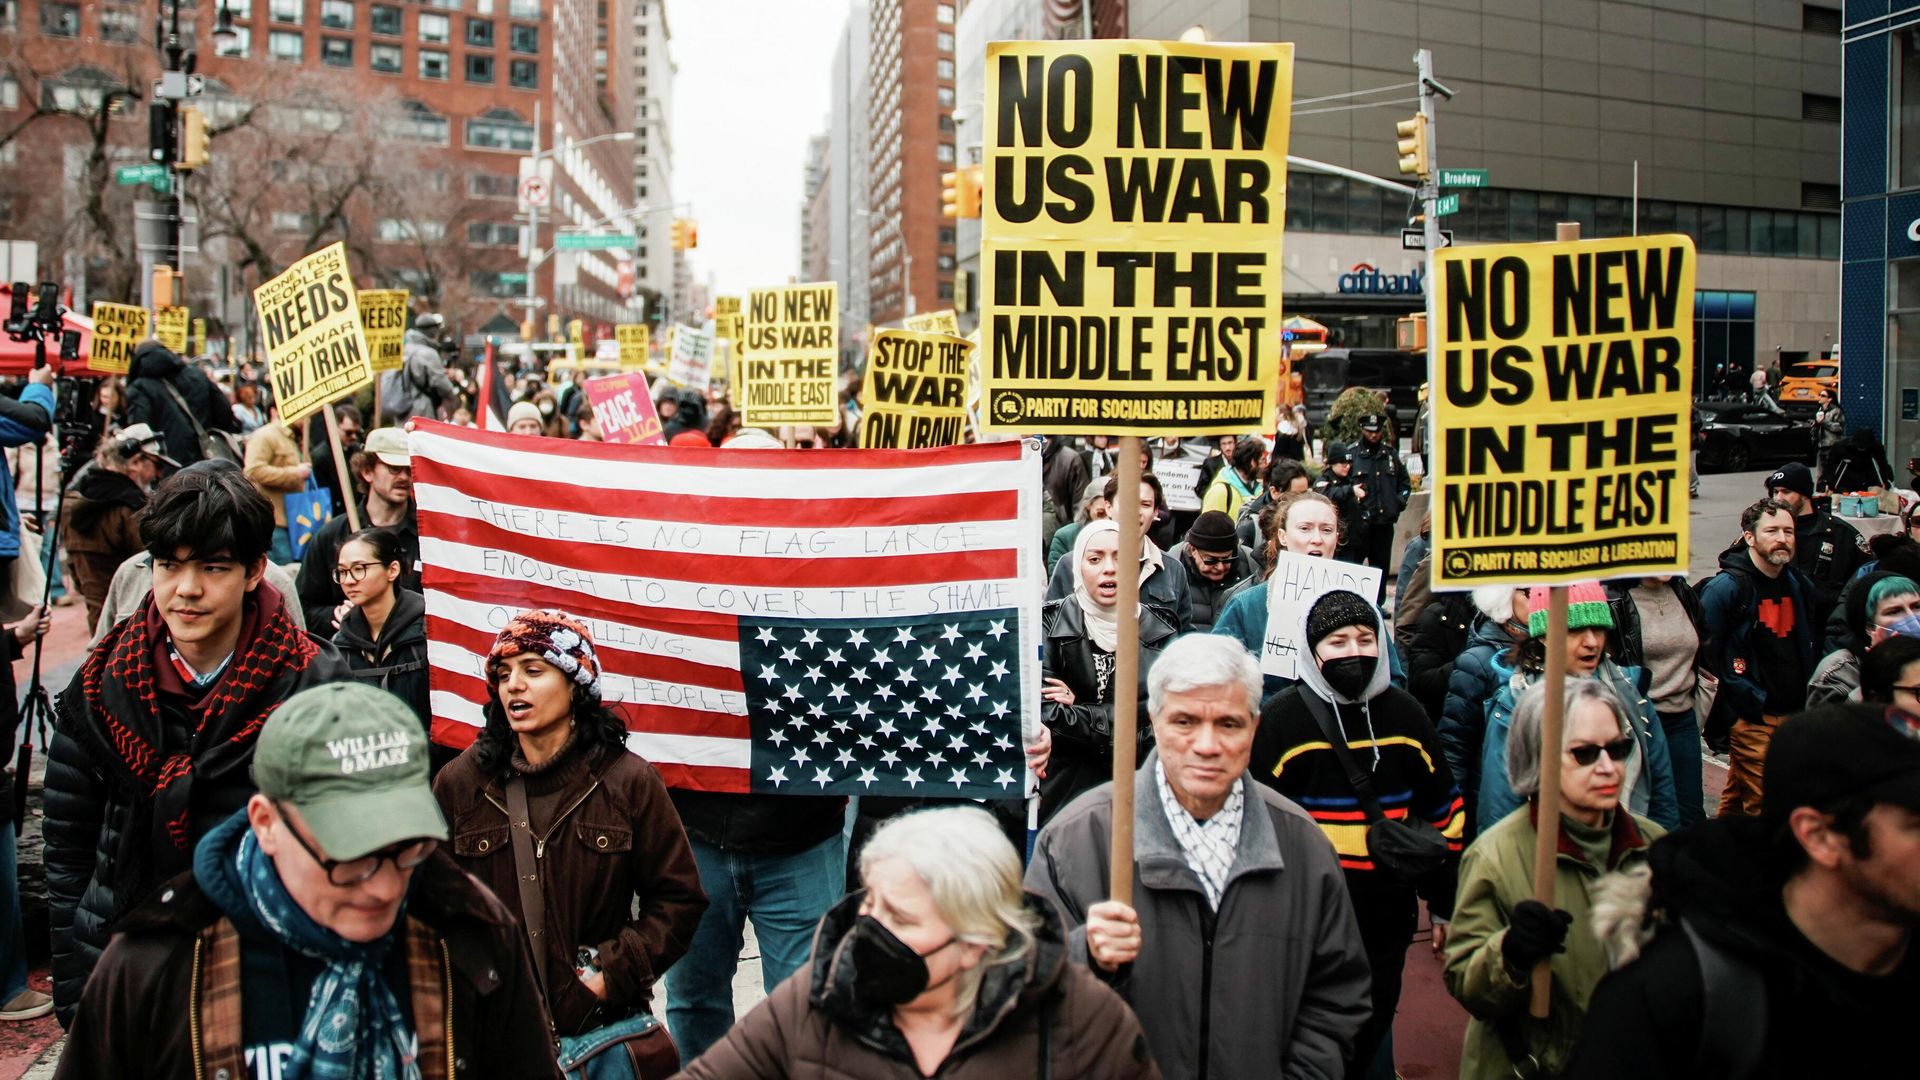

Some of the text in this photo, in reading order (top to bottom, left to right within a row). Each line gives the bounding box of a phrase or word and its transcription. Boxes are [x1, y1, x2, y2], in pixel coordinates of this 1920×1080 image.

[997, 54, 1278, 150] NO NEW
[995, 154, 1270, 223] US WAR
[1444, 172, 1481, 186] Broadway
[258, 249, 338, 300] MONEY FOR
[261, 259, 341, 312] PEOPLE'S
[994, 250, 1086, 306] IN
[1096, 251, 1267, 308] THE
[1339, 266, 1424, 294] citibank
[1446, 247, 1684, 343] NO NEW
[97, 306, 145, 326] HANDS
[265, 273, 349, 350] NEEDS
[750, 292, 777, 324] NO
[784, 289, 832, 323] NEW
[92, 338, 136, 361] IRAN
[273, 321, 354, 371] NOT WAR
[748, 326, 778, 350] US
[781, 325, 833, 348] WAR
[875, 337, 934, 372] STOP
[938, 342, 968, 375] THE
[993, 315, 1266, 381] MIDDLE EAST
[276, 333, 361, 400] W/ IRAN
[748, 360, 775, 380] IN
[780, 358, 832, 379] THE
[873, 371, 965, 408] WAR
[1446, 336, 1681, 407] US WAR
[593, 389, 643, 438] PEACE
[747, 381, 832, 406] MIDDLE EAST
[1026, 397, 1070, 418] PARTY
[1072, 398, 1099, 418] FOR
[1101, 399, 1173, 420] SOCIALISM
[1176, 401, 1188, 419] &
[1190, 398, 1263, 419] LIBERATION
[865, 412, 902, 449] ON
[1445, 414, 1678, 477] IN THE
[1155, 470, 1189, 479] ondemn
[470, 499, 984, 554] THERE IS NO FLAG LARGE
[1444, 469, 1676, 540] MIDDLE EAST
[1473, 552, 1512, 571] PARTY
[1513, 551, 1538, 570] FOR
[1540, 546, 1599, 570] SOCIALISM
[1601, 548, 1611, 563] &
[1611, 540, 1676, 559] LIBERATION
[482, 550, 1015, 614] ENOUGH TO COVER THE SHAME
[631, 677, 742, 714] PEOPLE
